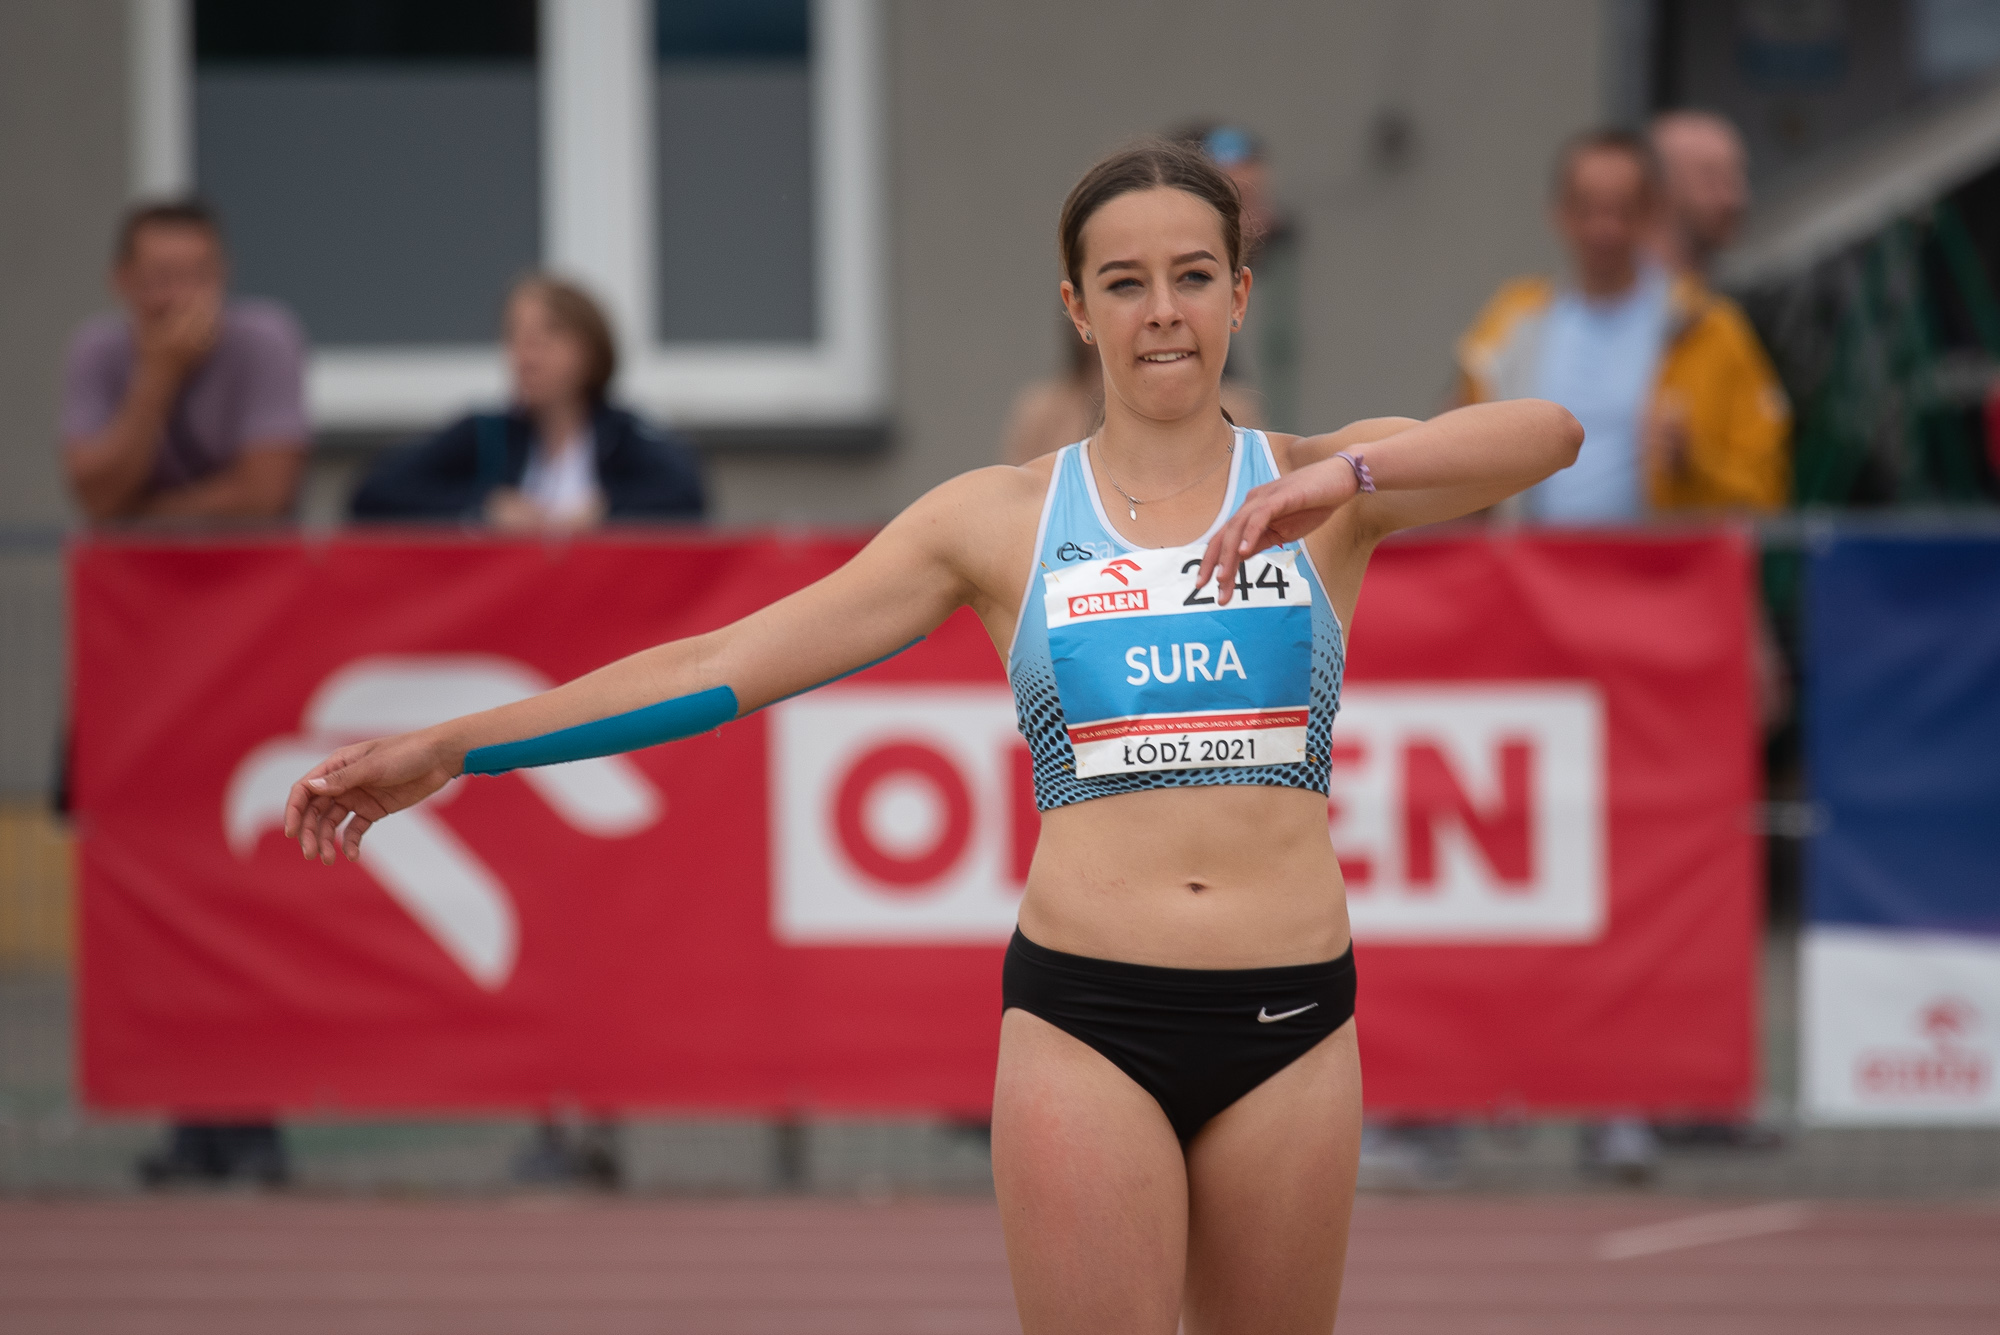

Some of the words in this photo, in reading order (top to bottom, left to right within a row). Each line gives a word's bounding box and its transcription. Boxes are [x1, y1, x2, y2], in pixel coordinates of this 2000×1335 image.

[1071, 591, 1146, 615] ORLEN
[1181, 558, 1290, 606] 244
[1125, 640, 1248, 686] SURA
[1123, 734, 1192, 765] ŁÓDŹ
[1200, 738, 1256, 761] 2021
[832, 736, 1535, 889] OEN
